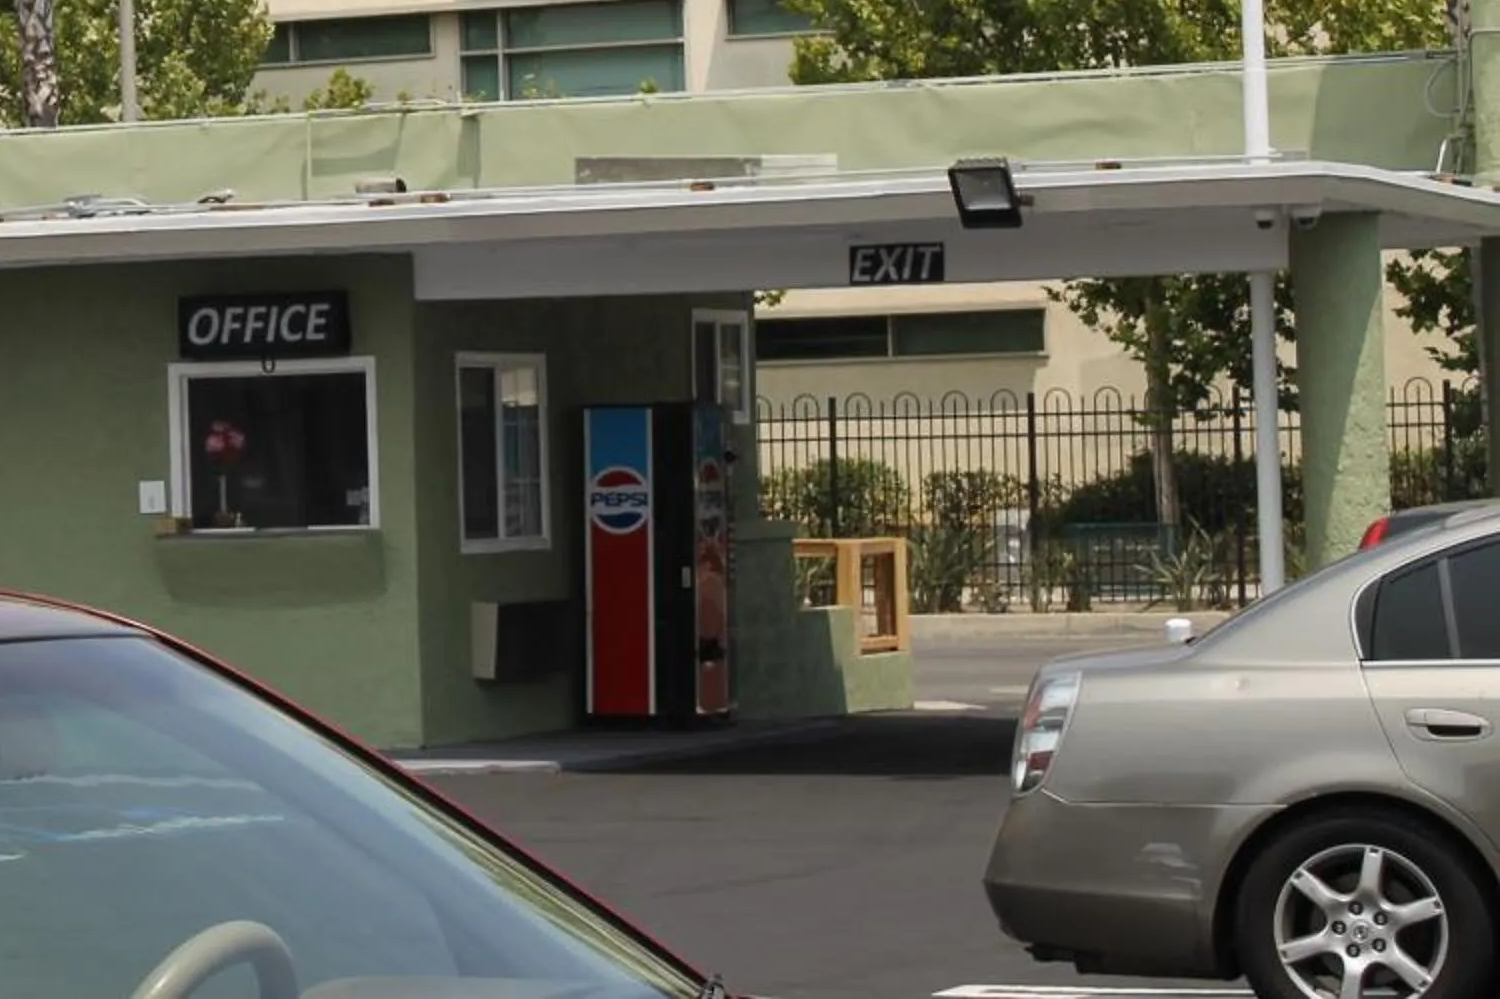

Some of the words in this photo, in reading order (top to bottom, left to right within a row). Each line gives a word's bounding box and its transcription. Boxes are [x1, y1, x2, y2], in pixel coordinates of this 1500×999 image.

[851, 246, 941, 282] EXIT
[187, 303, 331, 346] OFFICE
[590, 492, 649, 507] PEPSI
